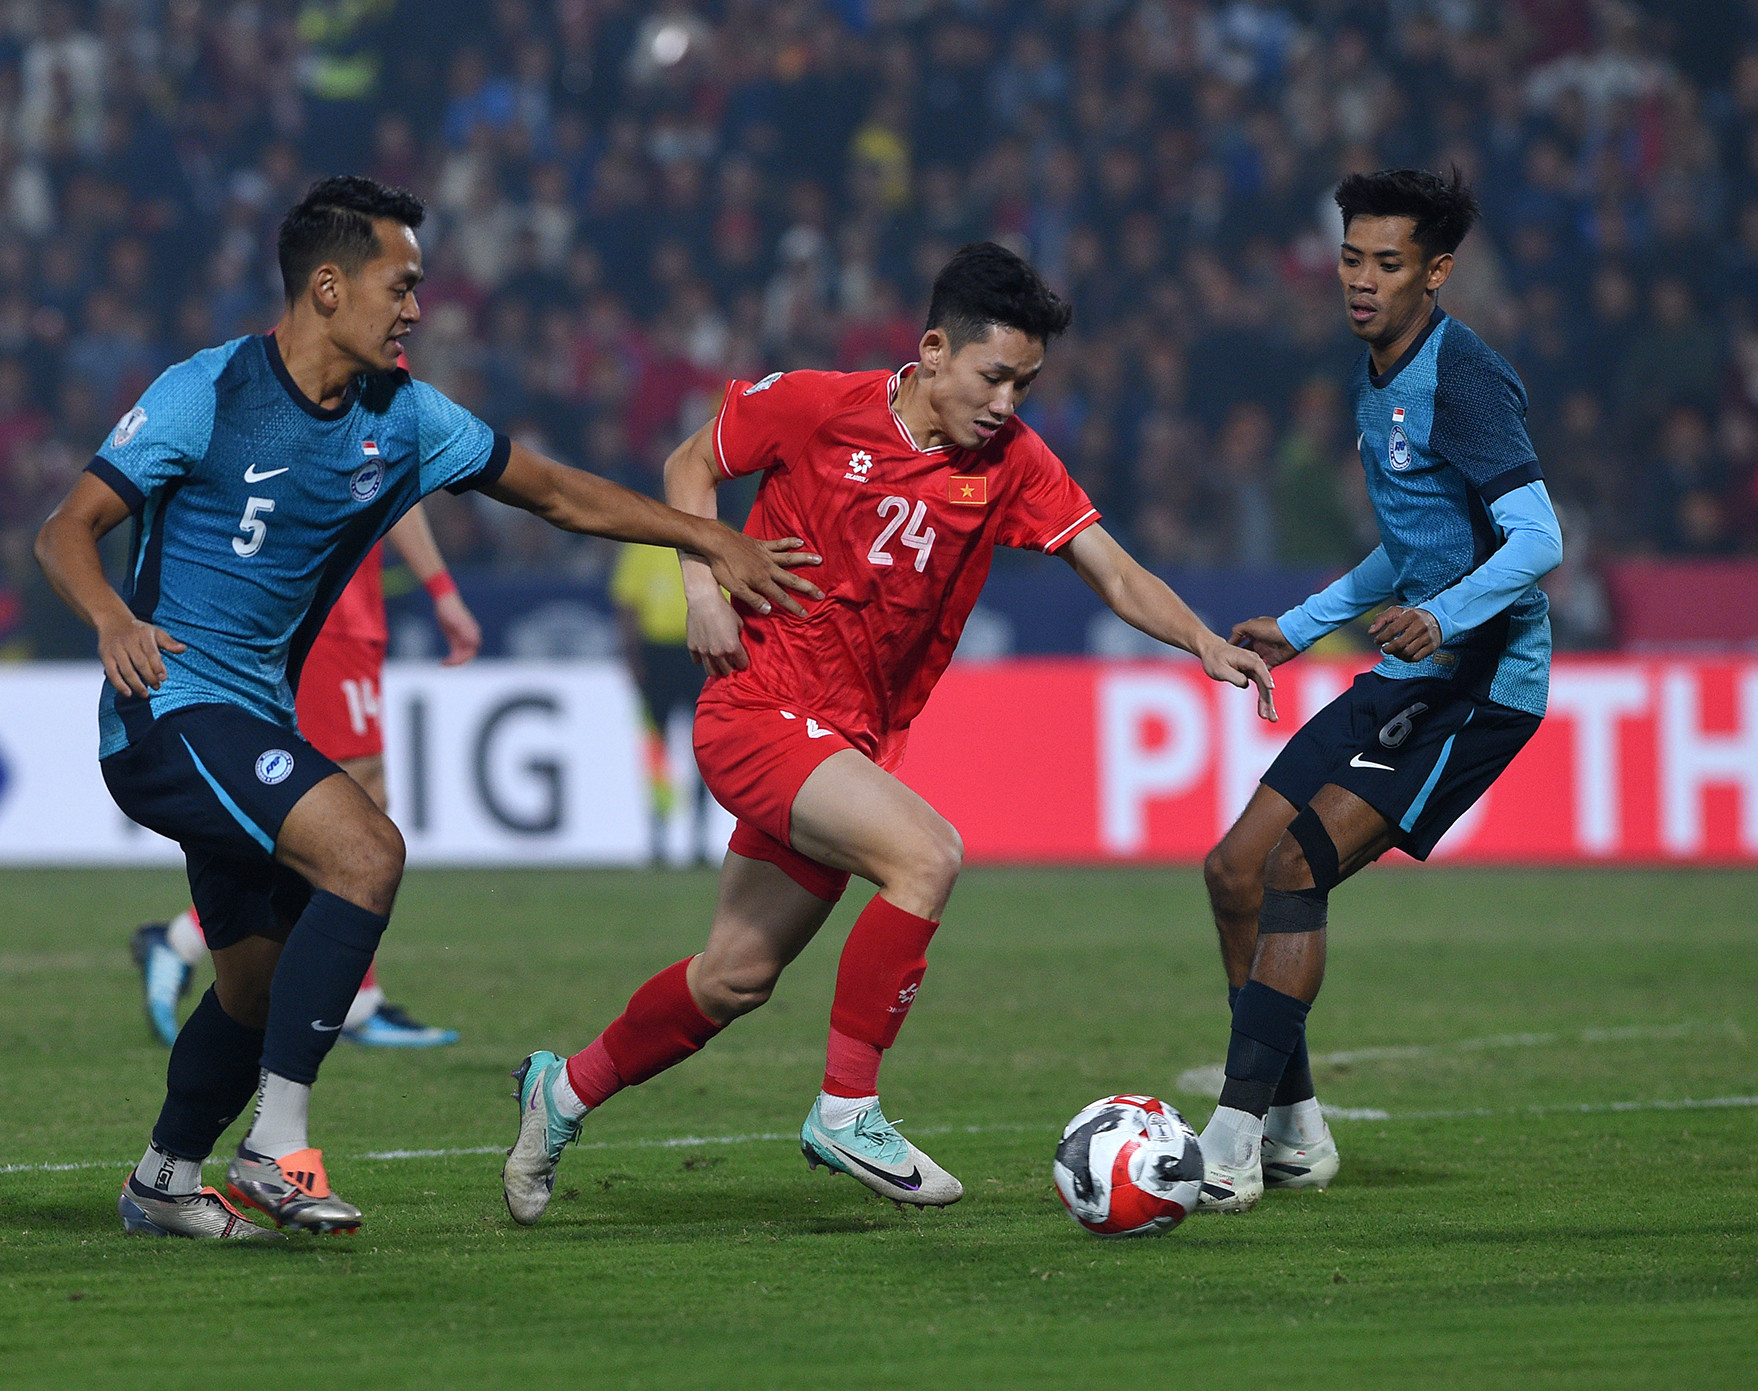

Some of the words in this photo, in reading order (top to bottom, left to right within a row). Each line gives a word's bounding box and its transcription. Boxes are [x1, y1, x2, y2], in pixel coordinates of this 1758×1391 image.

[232, 496, 275, 558] 5
[867, 495, 936, 573] 24
[341, 676, 383, 736] 14
[1379, 702, 1428, 748] 6
